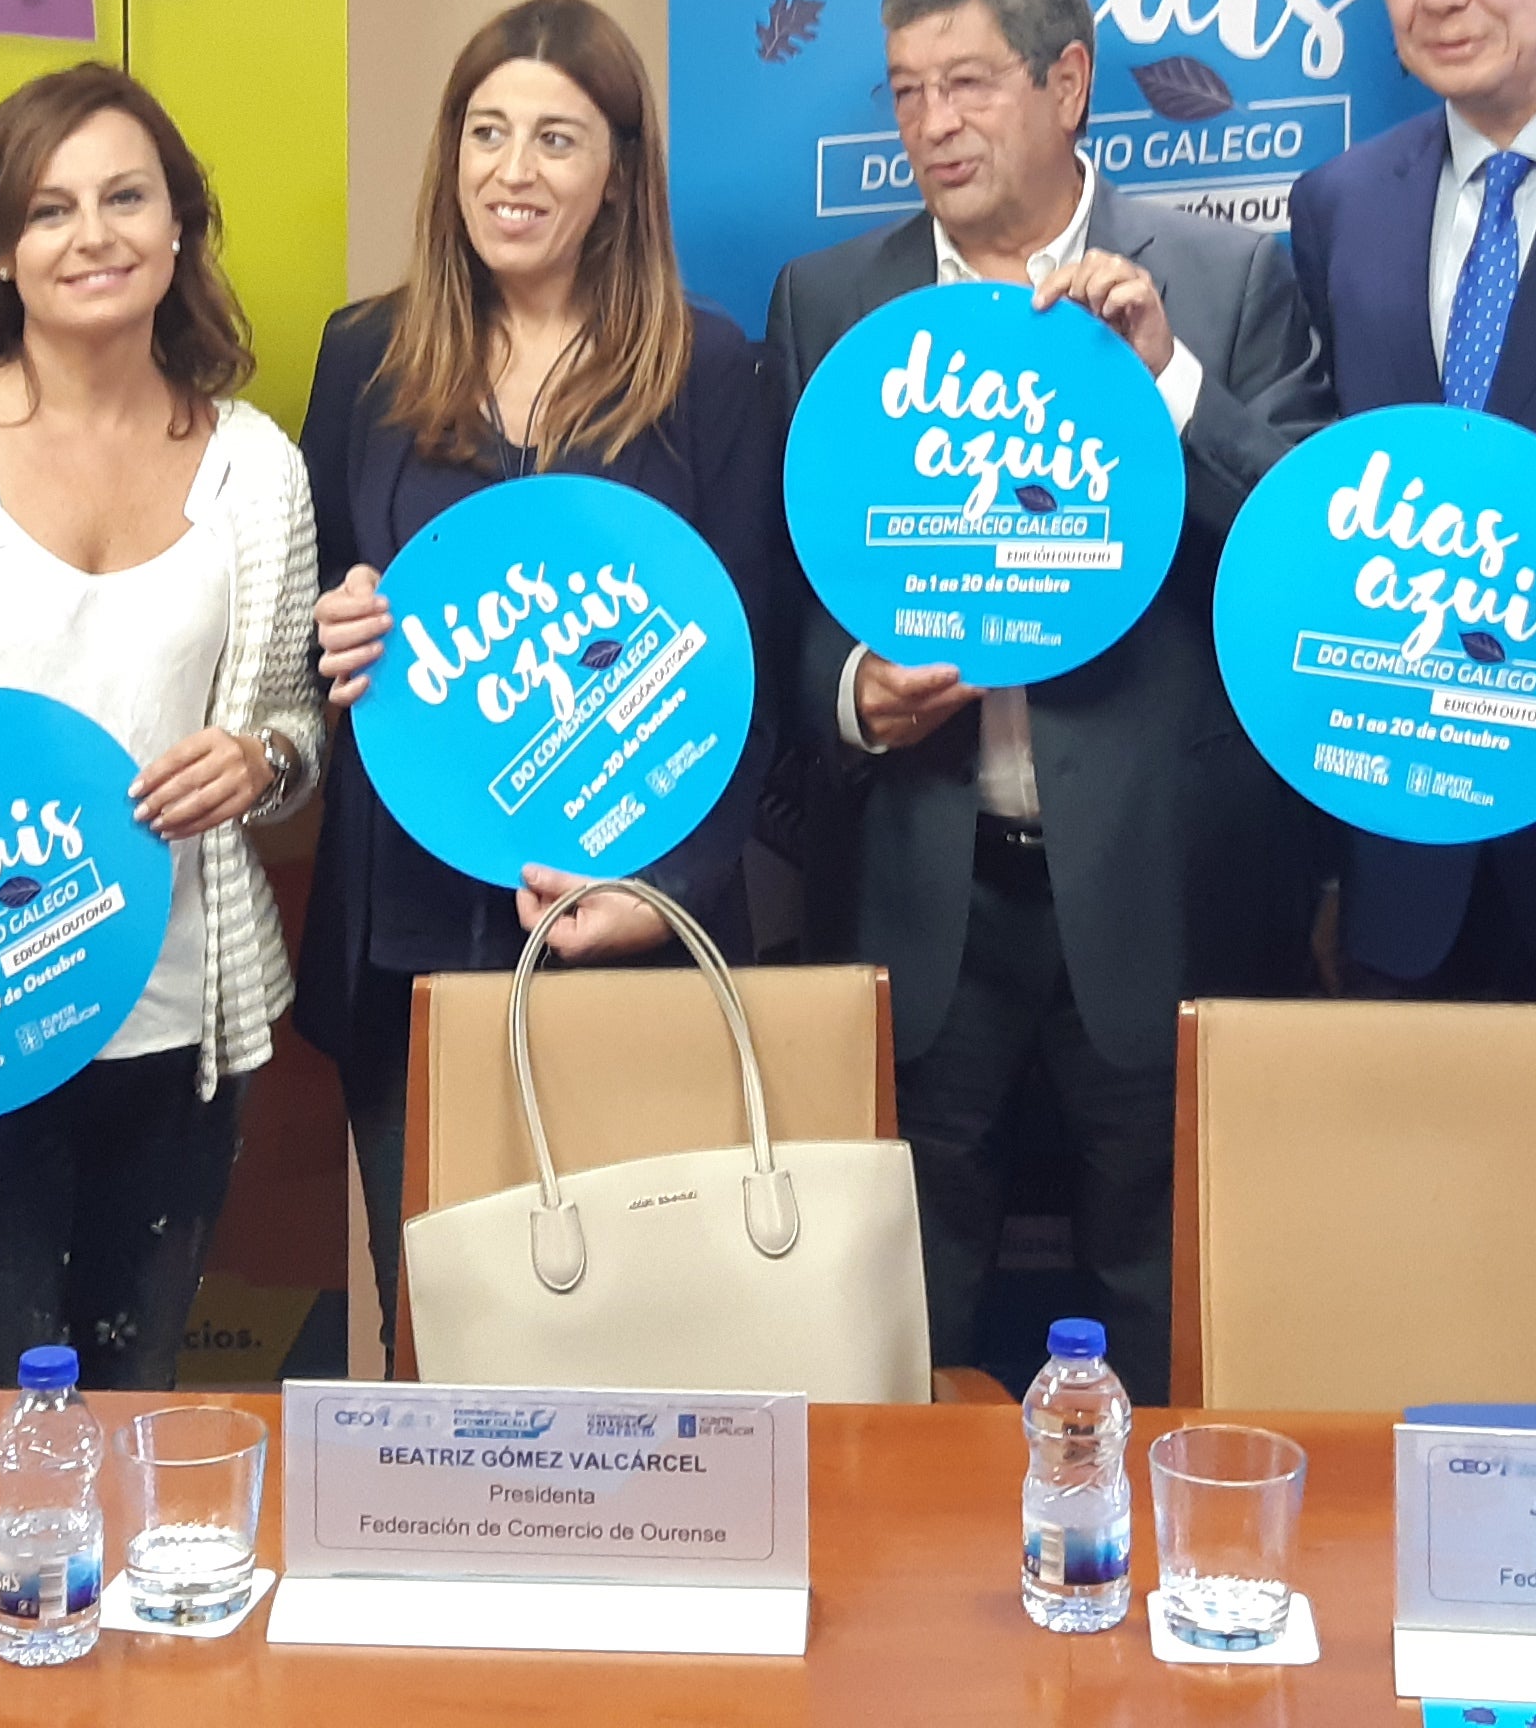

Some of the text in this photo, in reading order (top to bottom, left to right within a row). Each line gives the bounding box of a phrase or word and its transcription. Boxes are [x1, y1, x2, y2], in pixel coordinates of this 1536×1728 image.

[1144, 121, 1304, 170] GALEGO
[881, 329, 1056, 433] días
[914, 420, 1120, 521] azuis
[888, 517, 915, 535] DO
[1016, 516, 1088, 535] GALEGO
[1328, 450, 1519, 577] días
[401, 561, 558, 705] días
[477, 562, 649, 723] azuis
[1318, 645, 1347, 666] DO
[1458, 664, 1536, 691] GALEGO
[511, 761, 535, 791] DO
[603, 631, 658, 693] GALEGO
[1330, 710, 1510, 750] Do 1 ao 20 de Outubro
[9, 881, 79, 934] GALEGO
[13, 898, 112, 966] EDICIÓN OUTONO
[4, 987, 23, 1006] de
[23, 948, 86, 992] Outubro
[379, 1446, 706, 1472] BEATRIZ GÓMEZ VALCÁRCEL
[490, 1485, 594, 1504] Presidenta
[360, 1515, 726, 1542] Federación de Comercio de Ourense
